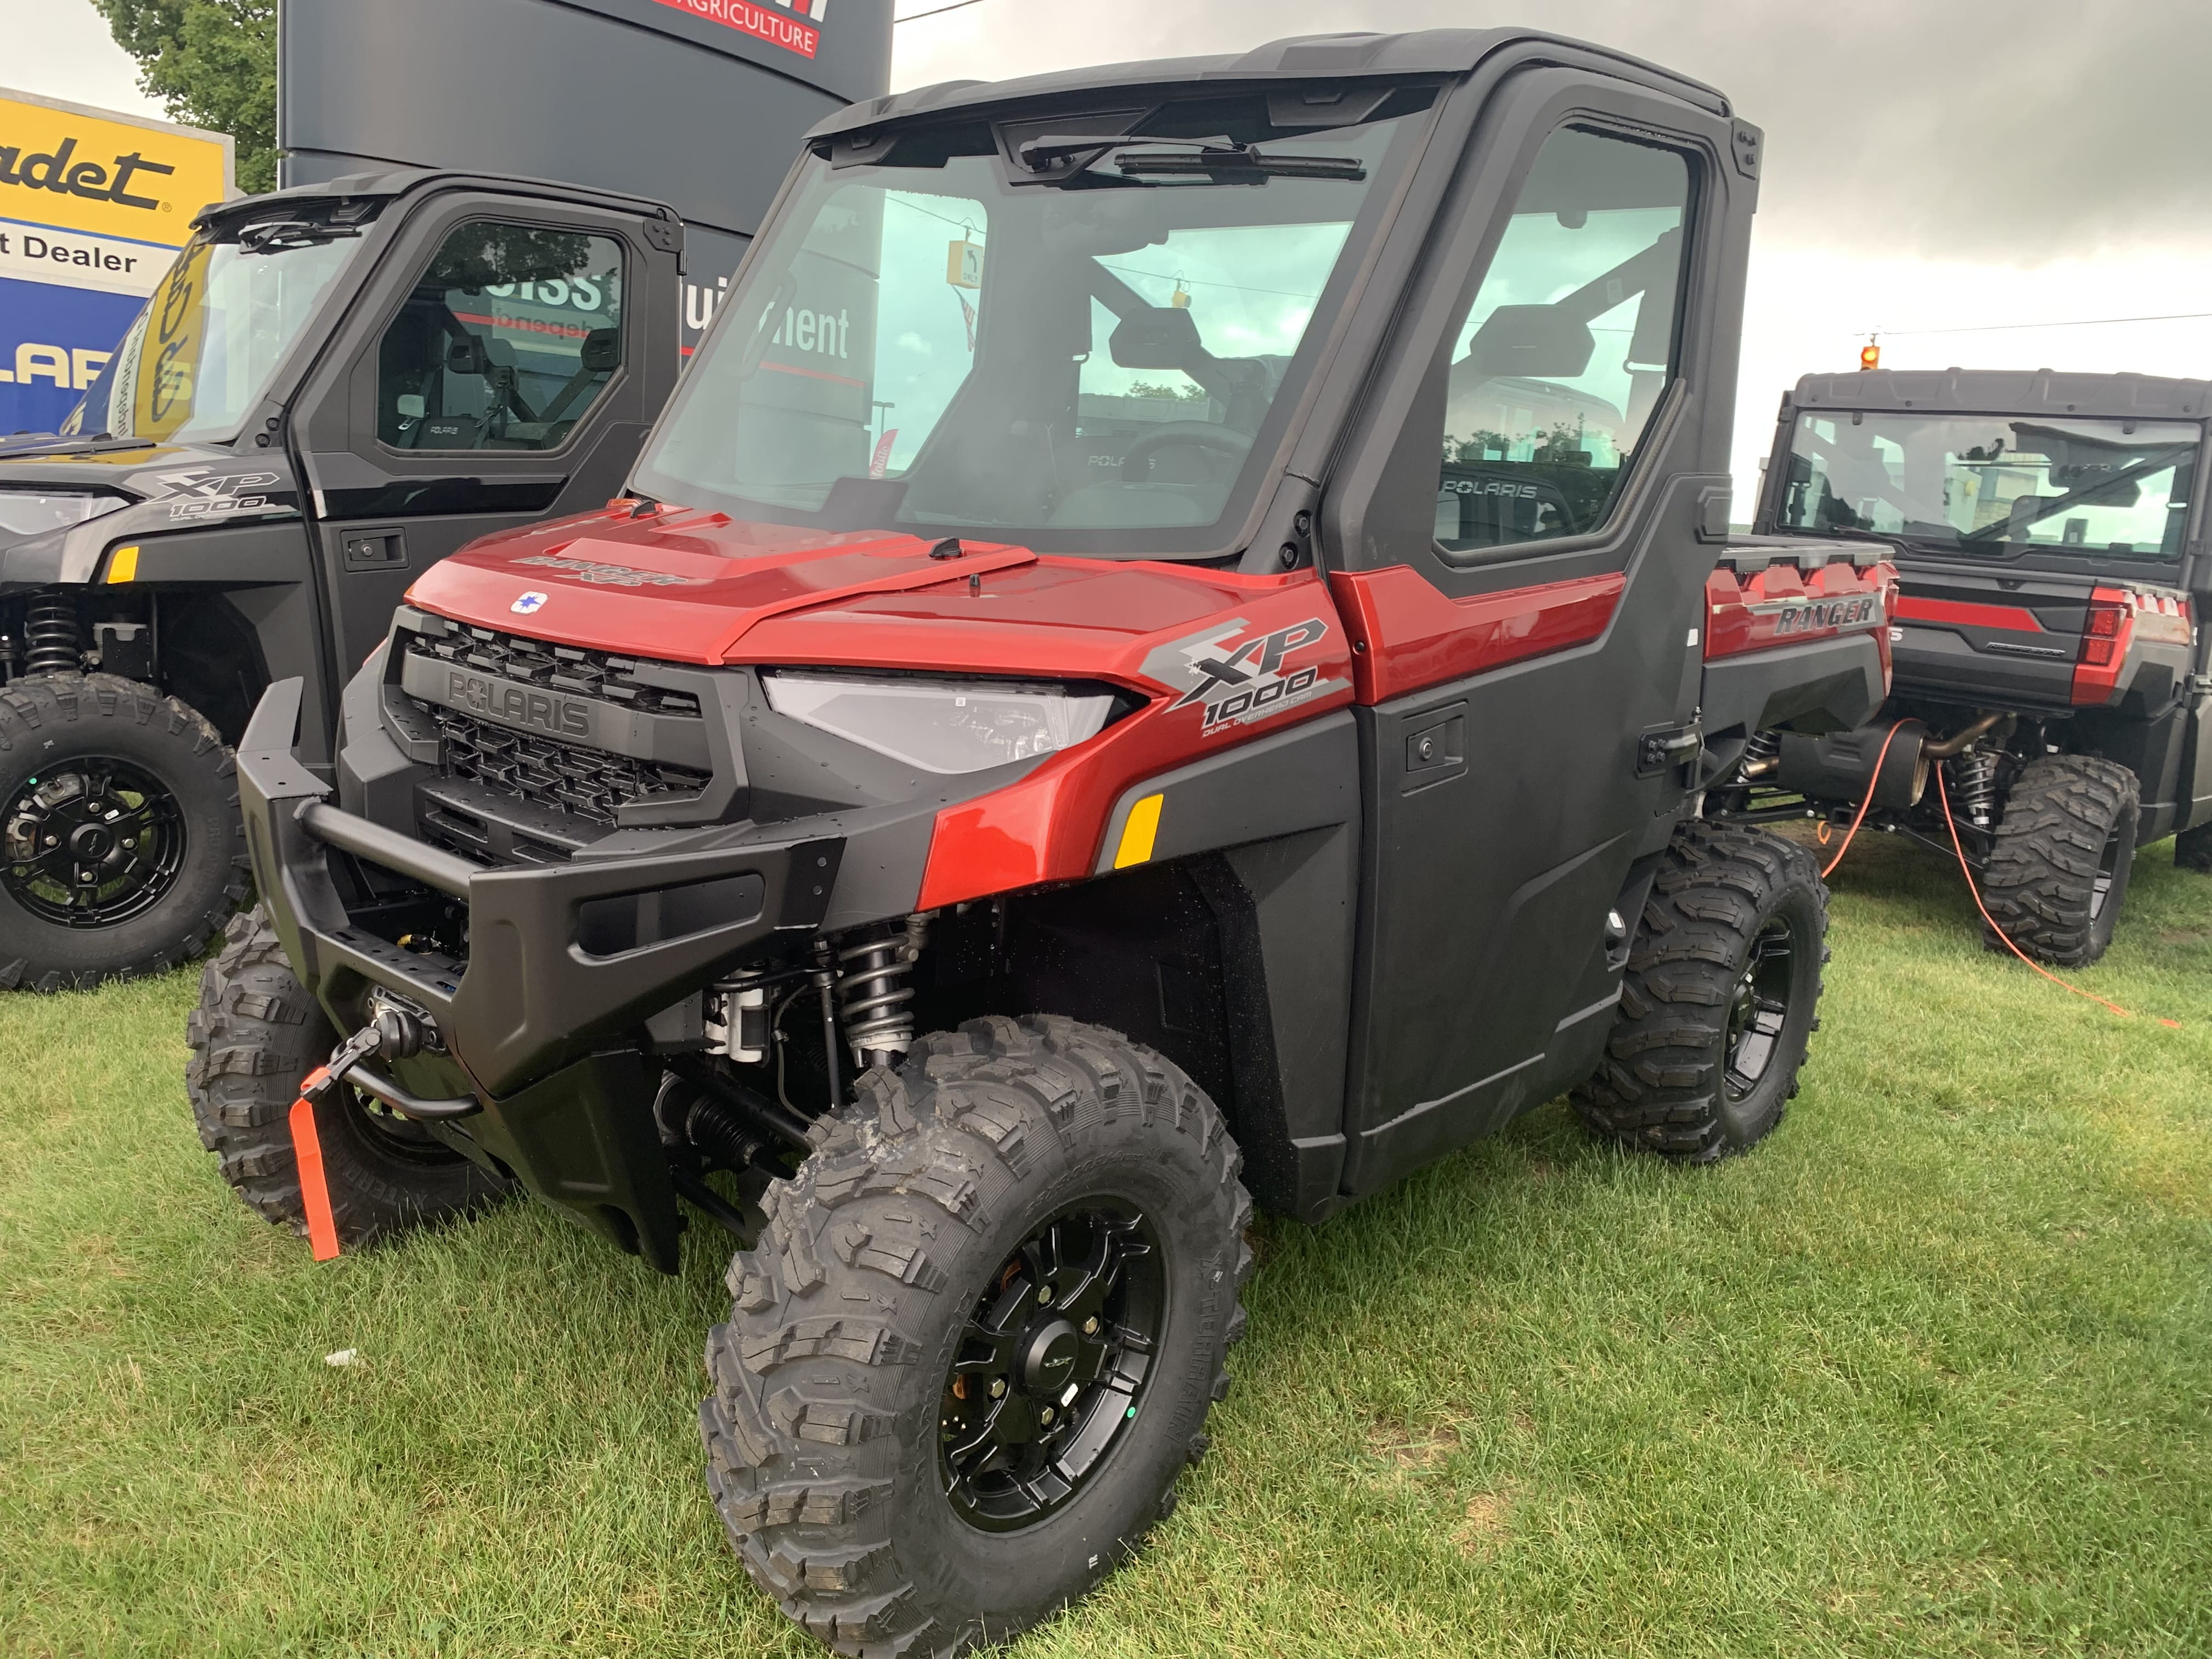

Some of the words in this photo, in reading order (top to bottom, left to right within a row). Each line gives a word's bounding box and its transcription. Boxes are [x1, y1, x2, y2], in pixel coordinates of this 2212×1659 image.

[24, 235, 137, 273] Dealer
[963, 272, 979, 283] ONLY
[430, 426, 459, 435] POLARIS
[138, 472, 281, 506] XP
[169, 495, 267, 517] 1000
[1441, 480, 1538, 499] POLARIS
[507, 555, 689, 586] RANGER
[1773, 596, 1875, 636] RANGER
[1162, 617, 1329, 715] XP
[448, 671, 590, 738] POLARIS
[1201, 665, 1318, 730] 1000
[1202, 723, 1232, 738] DUAL
[1233, 699, 1290, 726] OVERHEAD
[1289, 691, 1313, 704] CAM
